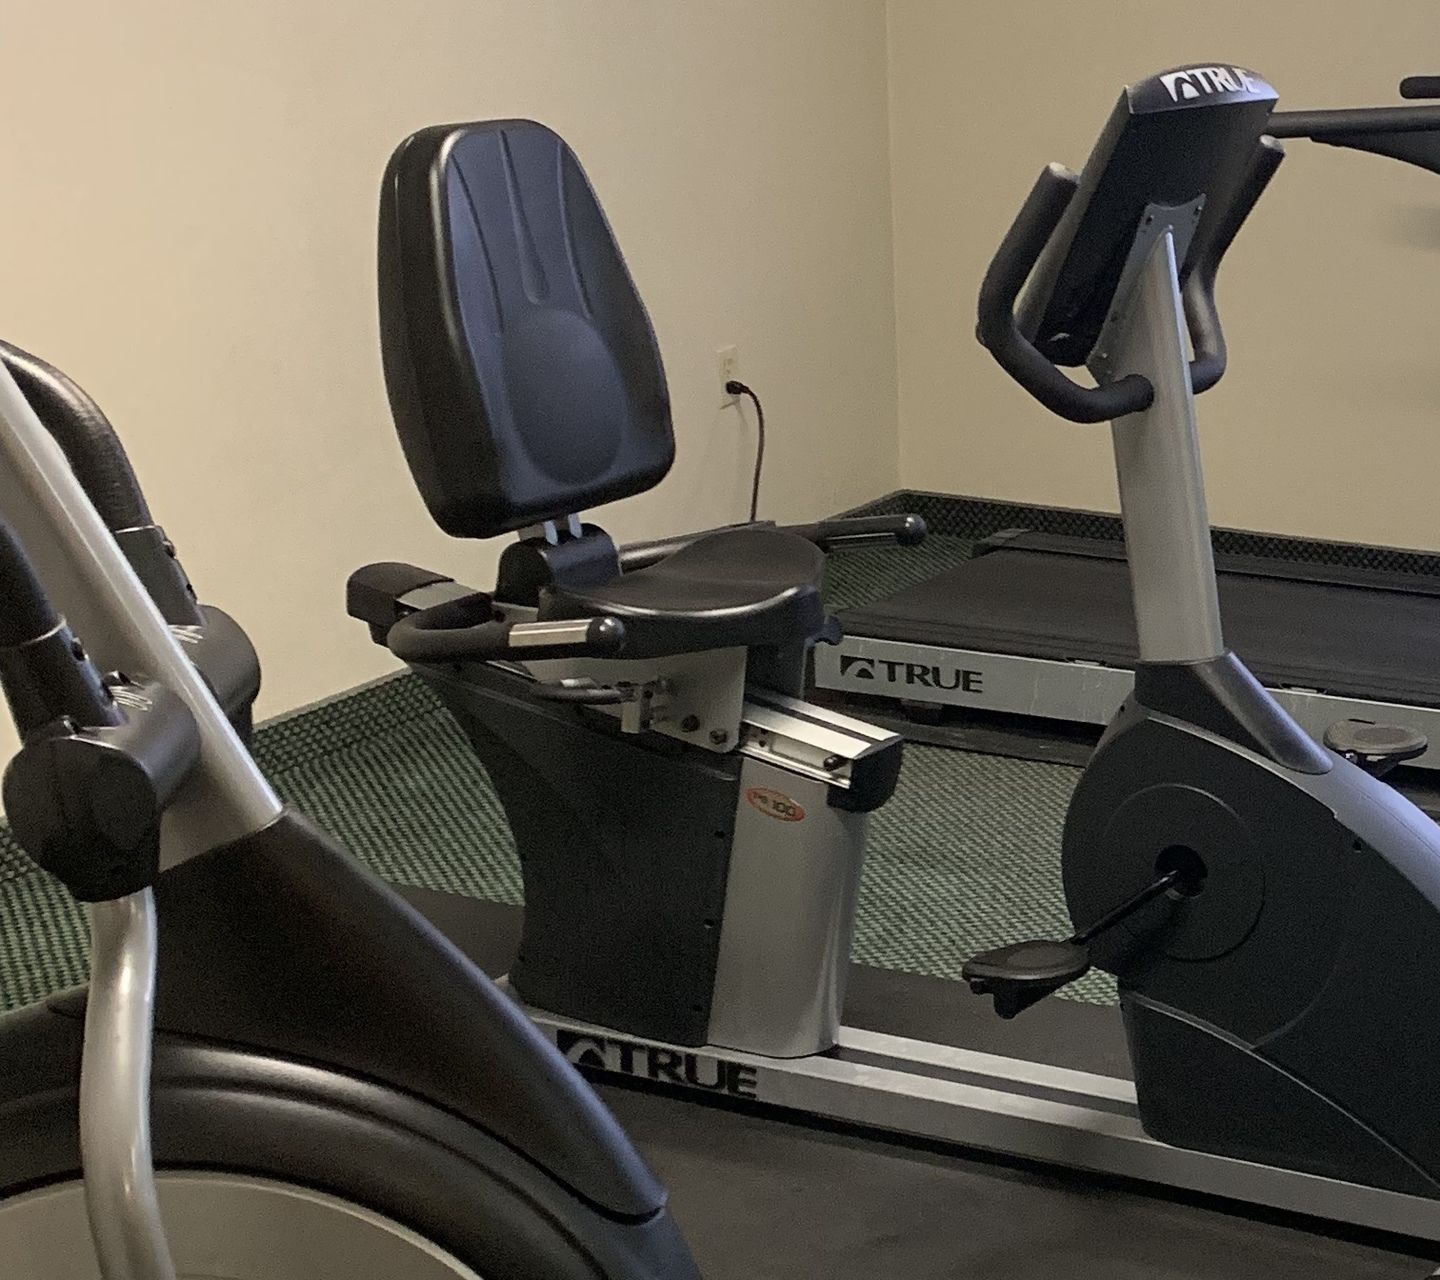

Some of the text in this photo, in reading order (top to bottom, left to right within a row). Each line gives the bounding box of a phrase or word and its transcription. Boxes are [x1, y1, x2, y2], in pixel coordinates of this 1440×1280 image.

[1185, 67, 1261, 94] TRUE
[878, 659, 983, 694] TRUE
[607, 1036, 758, 1099] TRUE
